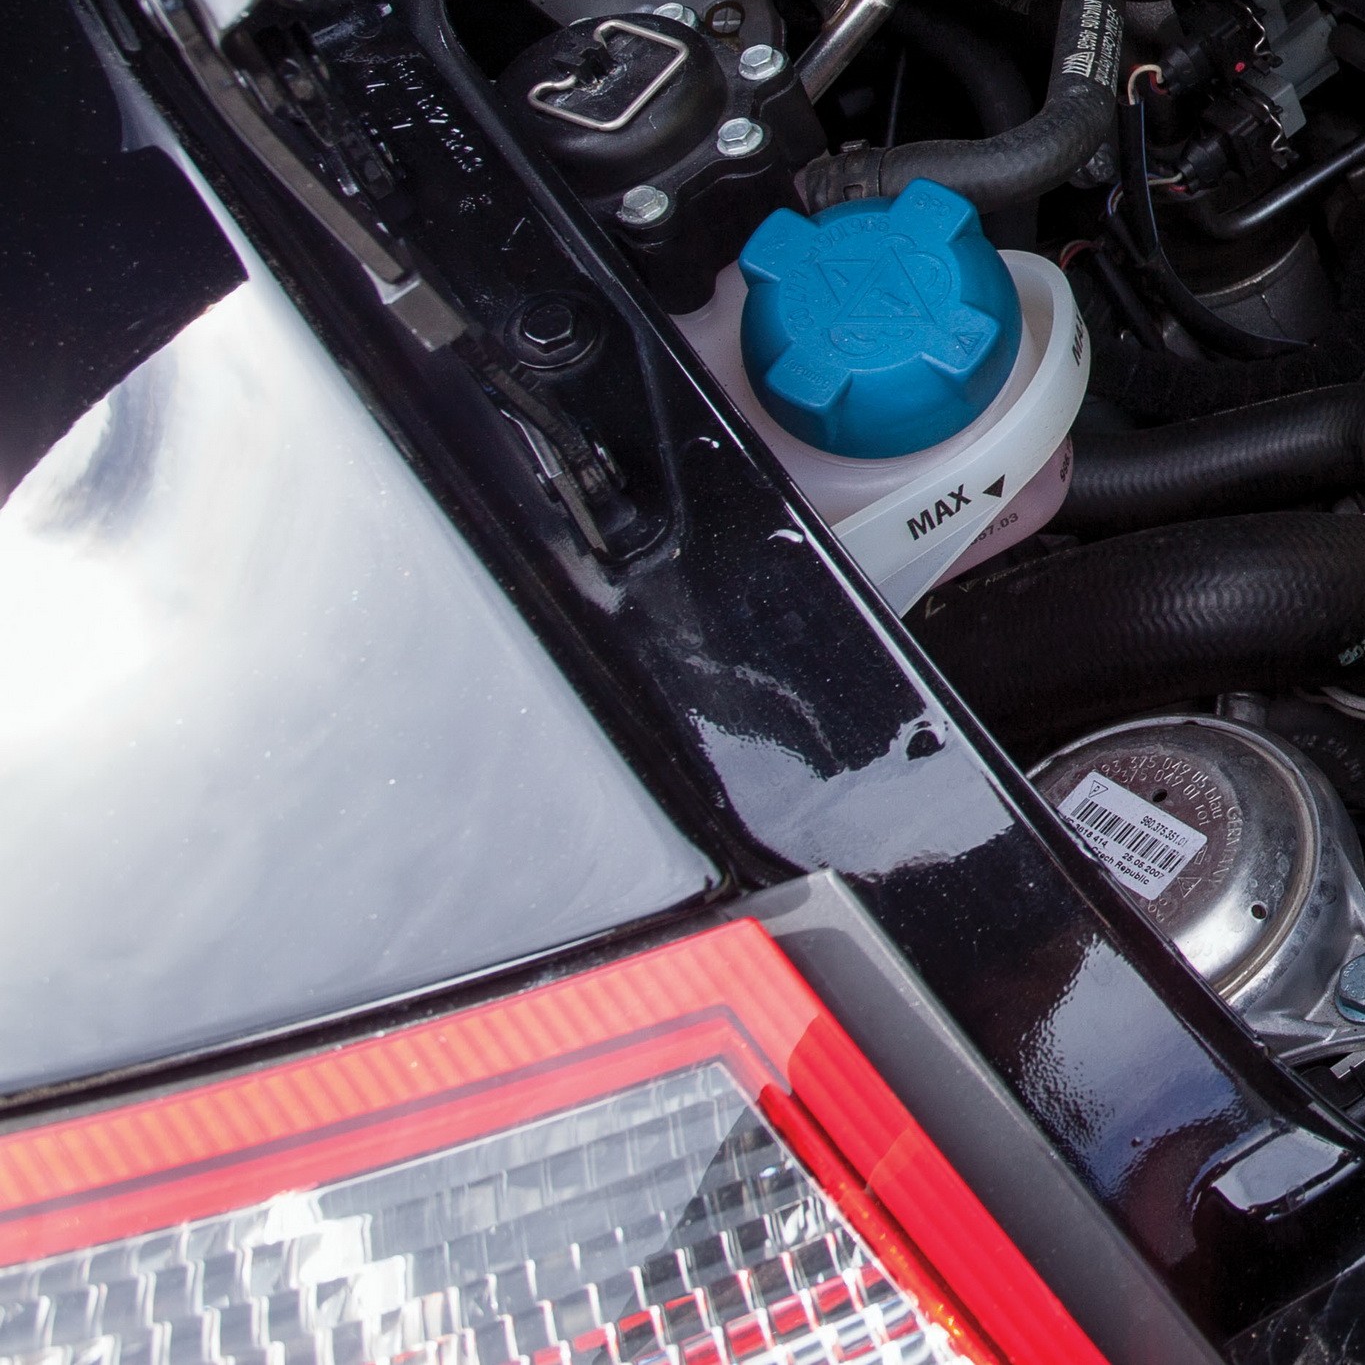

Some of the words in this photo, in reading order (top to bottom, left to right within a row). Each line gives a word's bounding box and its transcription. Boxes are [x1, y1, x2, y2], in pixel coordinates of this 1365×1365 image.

[906, 484, 972, 541] MAX
[1130, 755, 1157, 770] 375
[1203, 786, 1223, 820] blau
[1091, 845, 1115, 865] Czech
[1114, 861, 1150, 886] Republic
[1092, 835, 1109, 849] 414
[1121, 851, 1165, 880] 25.05.2007
